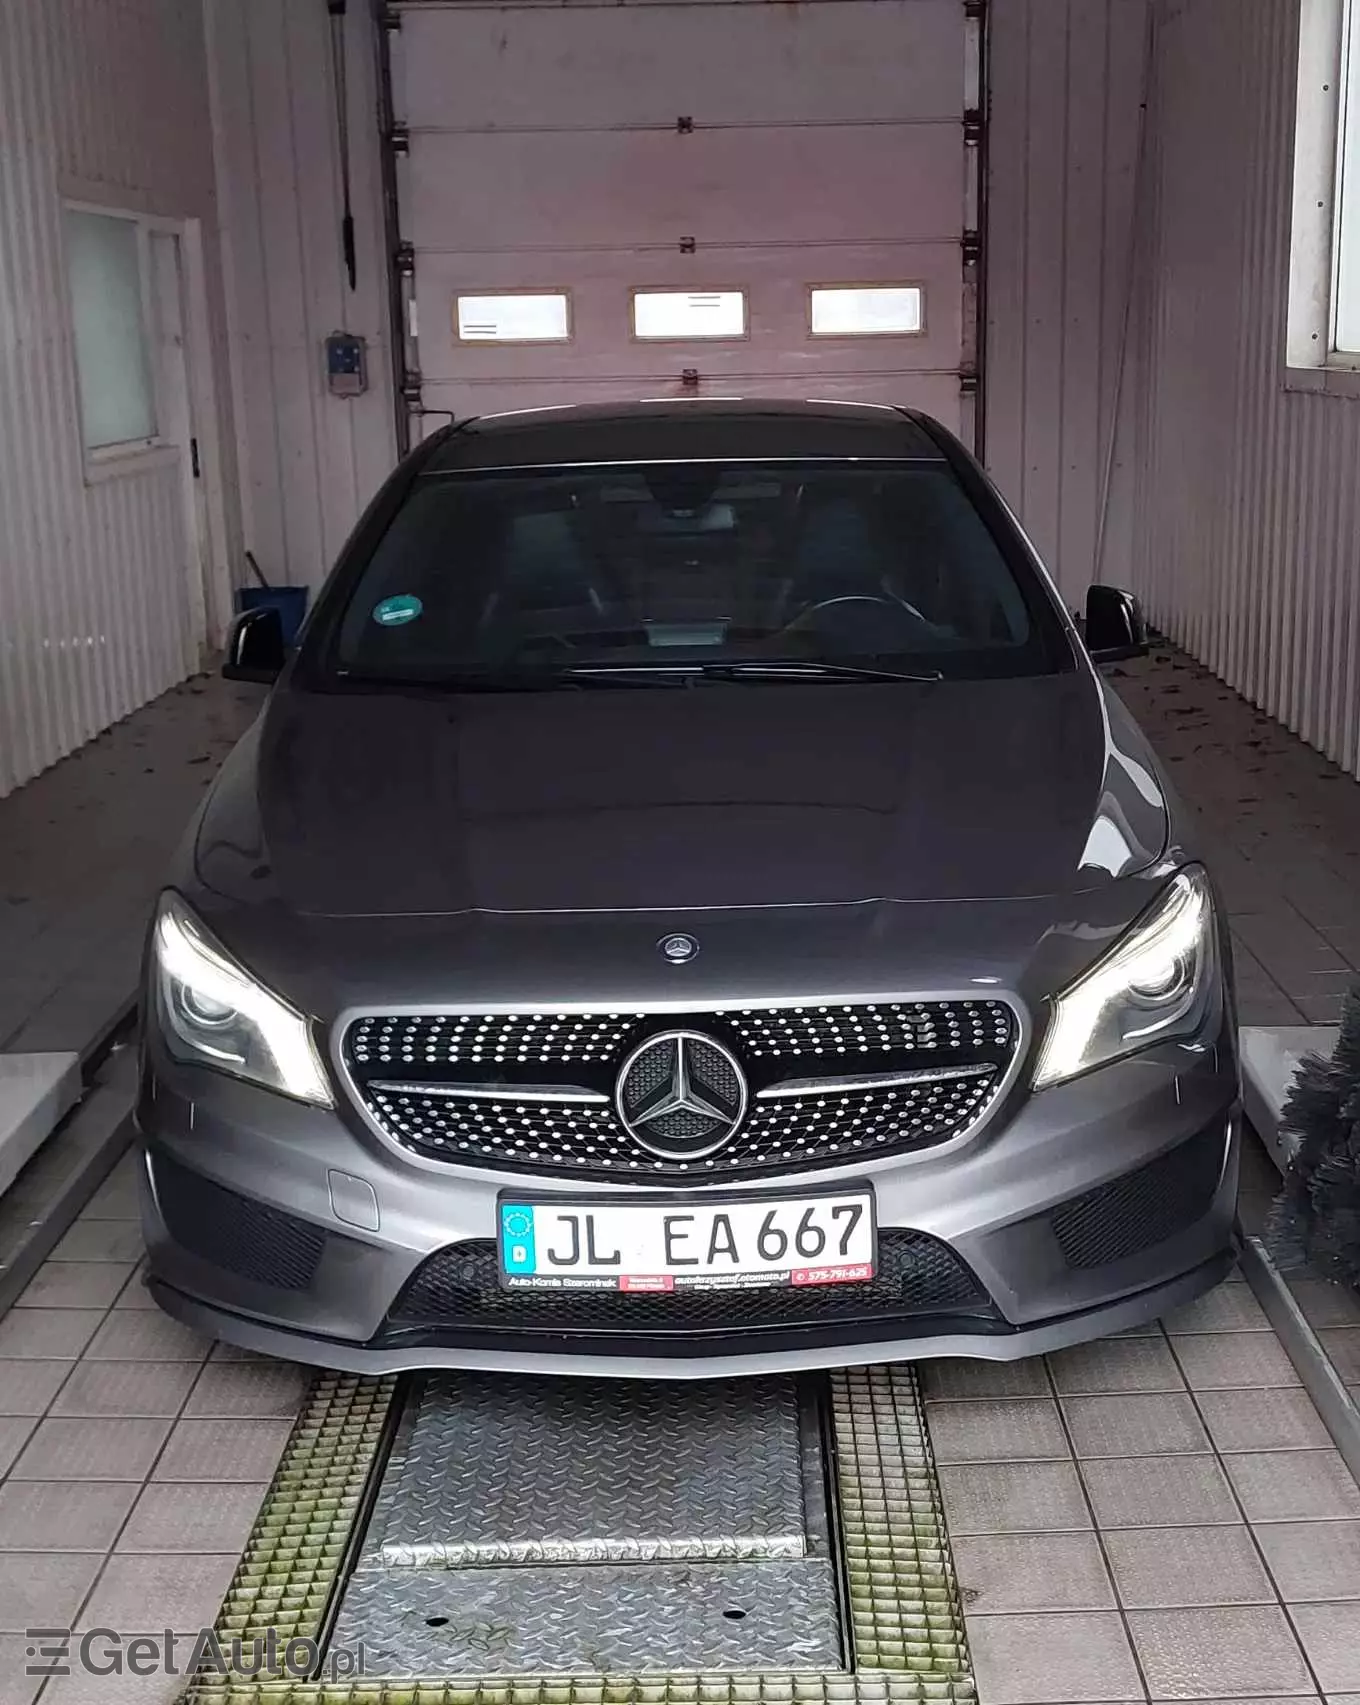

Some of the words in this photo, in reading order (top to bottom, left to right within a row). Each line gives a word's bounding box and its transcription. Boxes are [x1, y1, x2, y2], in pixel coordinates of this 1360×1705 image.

[512, 1245, 526, 1262] D
[547, 1215, 621, 1265] JL
[663, 1214, 740, 1265] EA
[757, 1204, 864, 1261] 667
